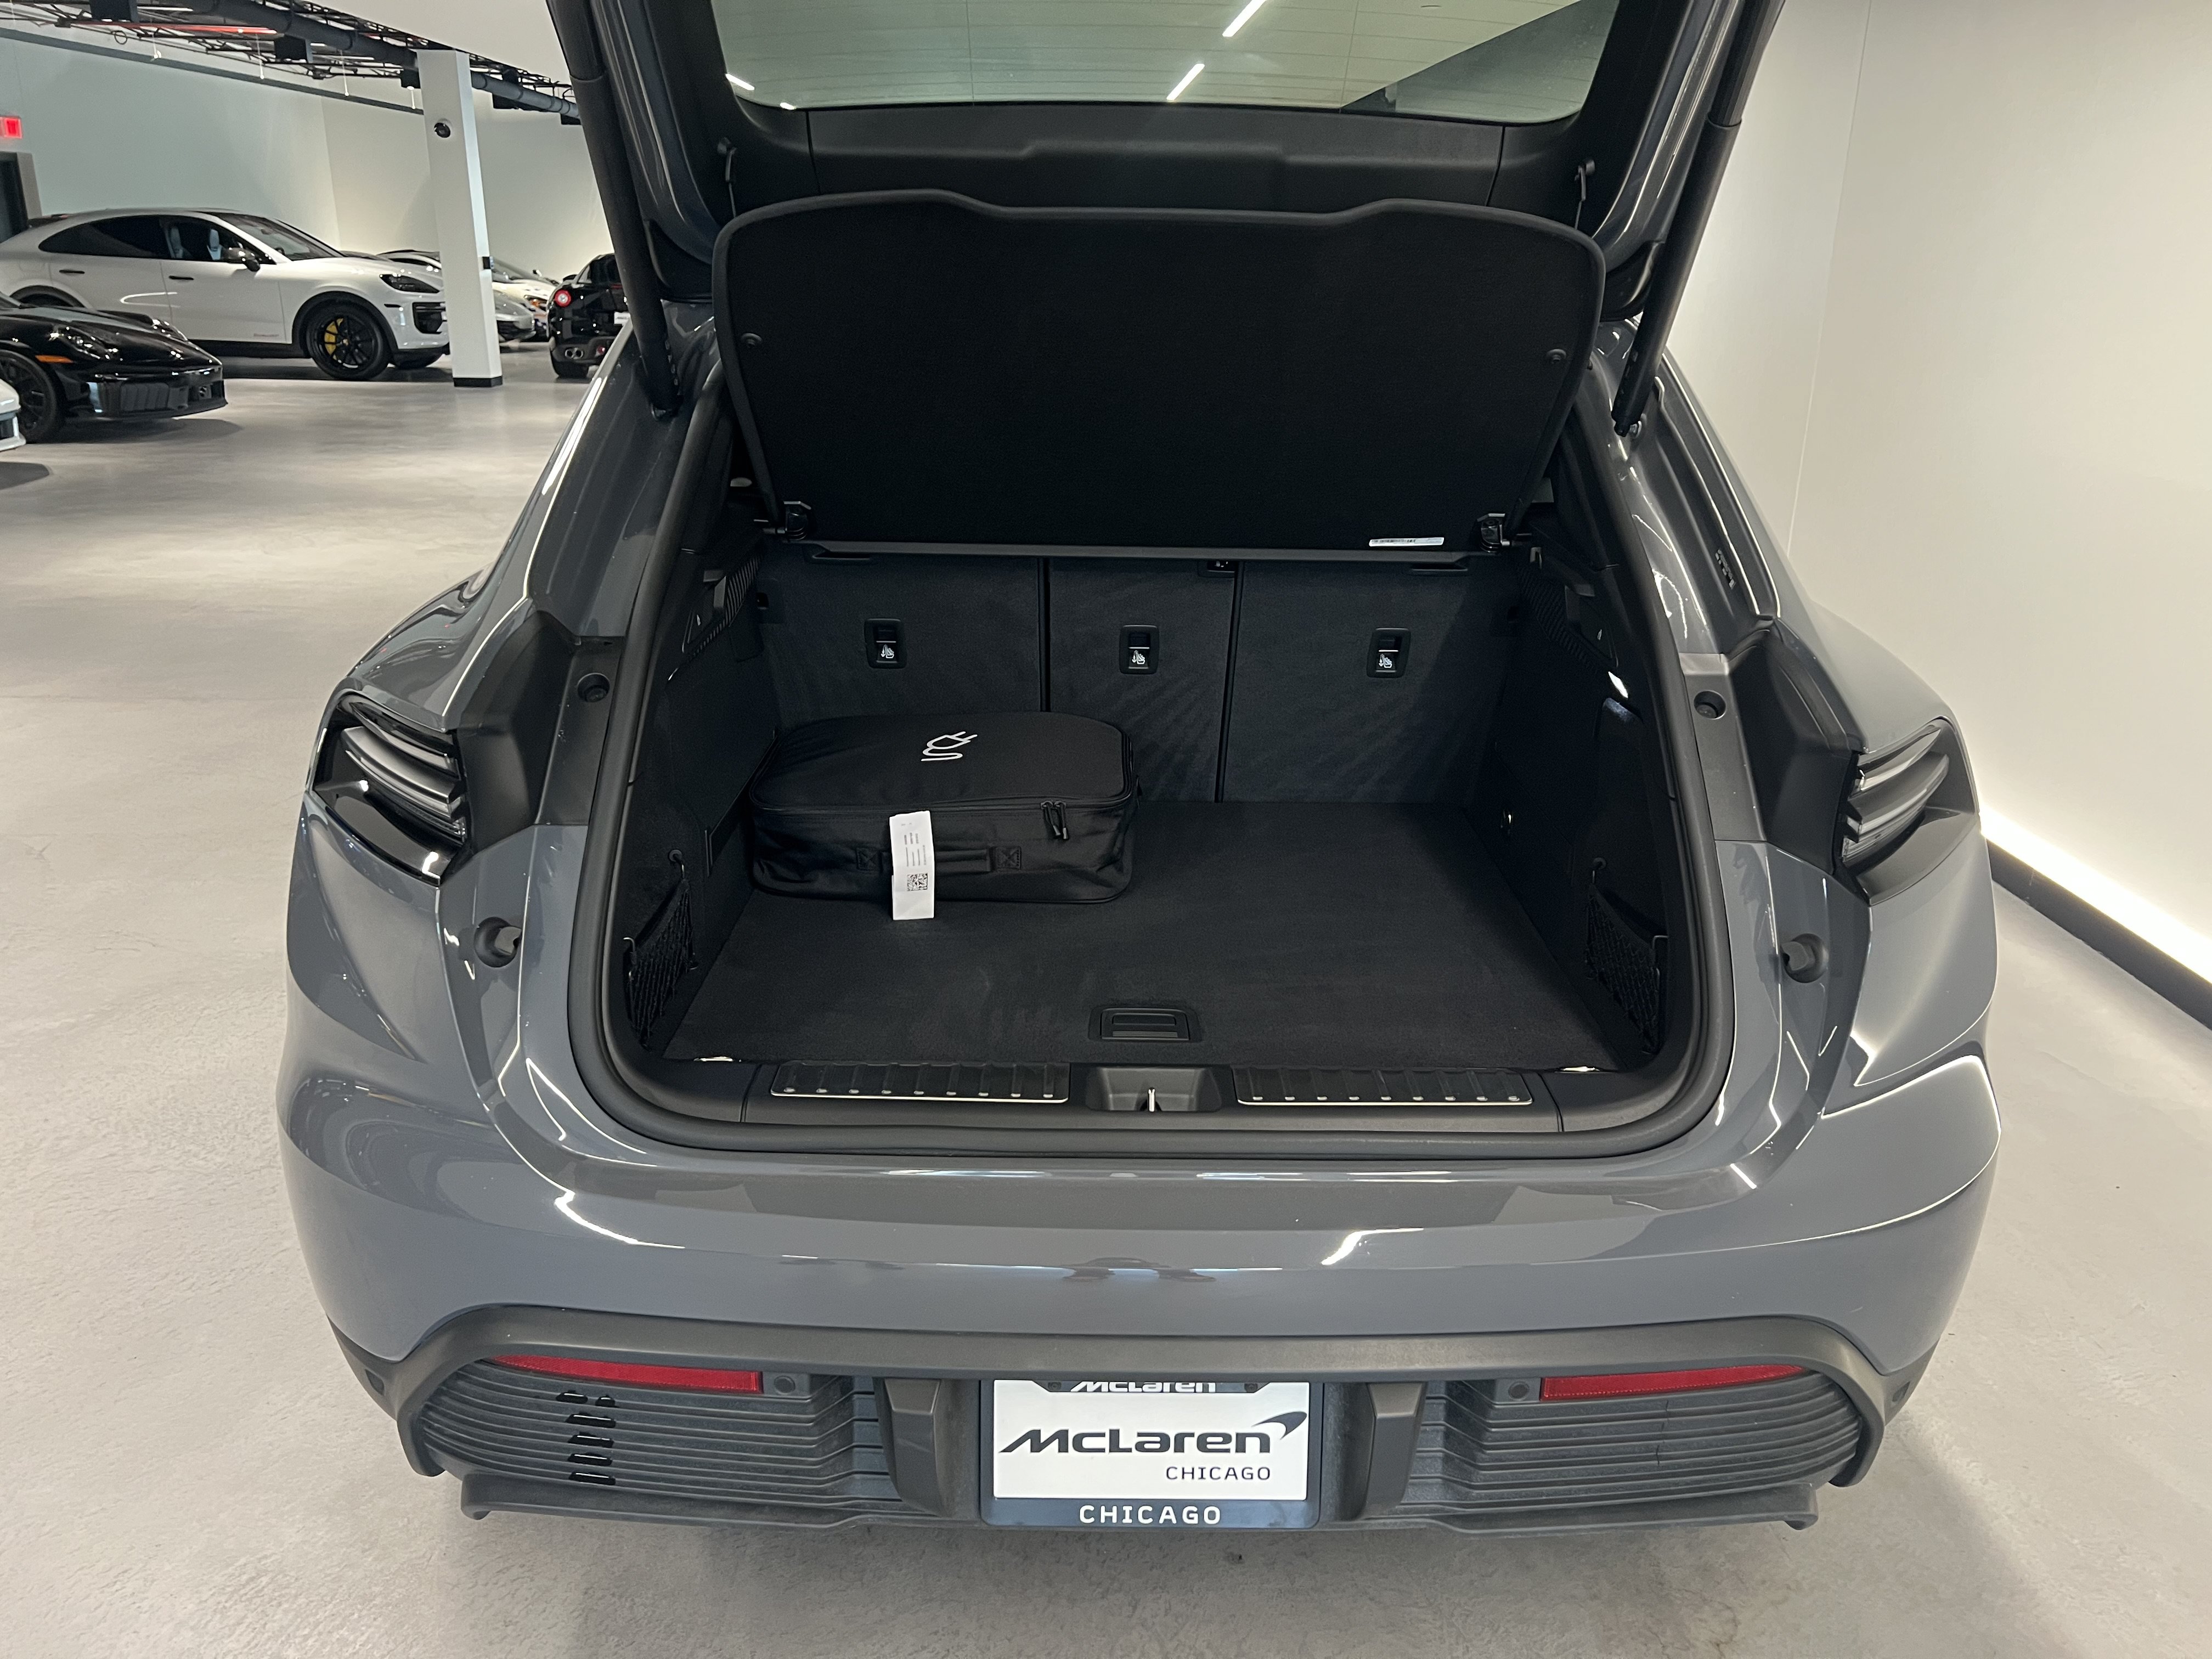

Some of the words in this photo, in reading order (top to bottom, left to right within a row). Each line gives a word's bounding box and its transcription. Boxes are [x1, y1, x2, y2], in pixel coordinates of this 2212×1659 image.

[1070, 1381, 1216, 1392] McLaren
[1000, 1429, 1271, 1453] McLaren
[1166, 1466, 1271, 1480] CHICAGO
[1079, 1505, 1221, 1524] CHICAGO
